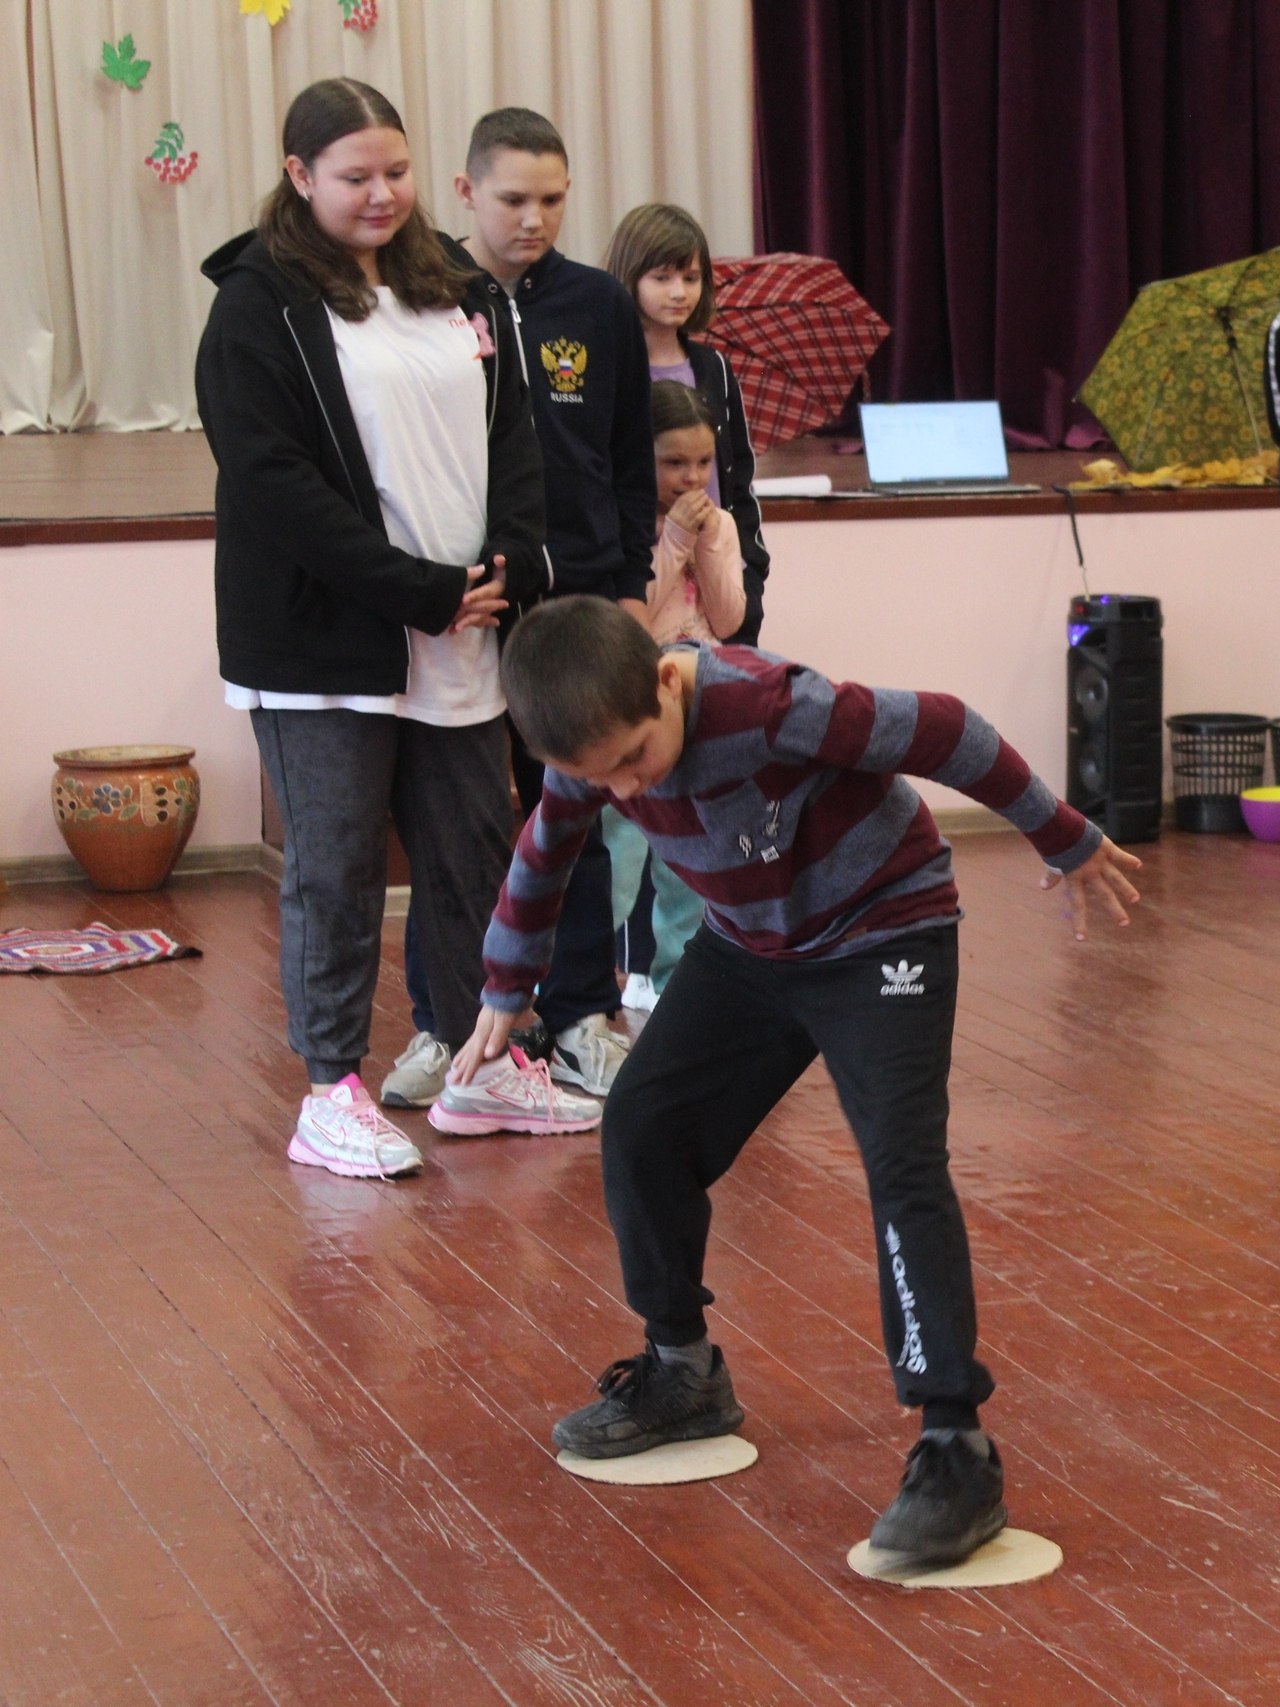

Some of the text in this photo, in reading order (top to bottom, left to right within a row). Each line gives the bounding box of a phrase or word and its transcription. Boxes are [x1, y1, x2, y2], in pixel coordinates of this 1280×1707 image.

[550, 392, 583, 403] RUSSIA
[880, 981, 925, 996] adidas
[892, 1254, 927, 1375] adidas
